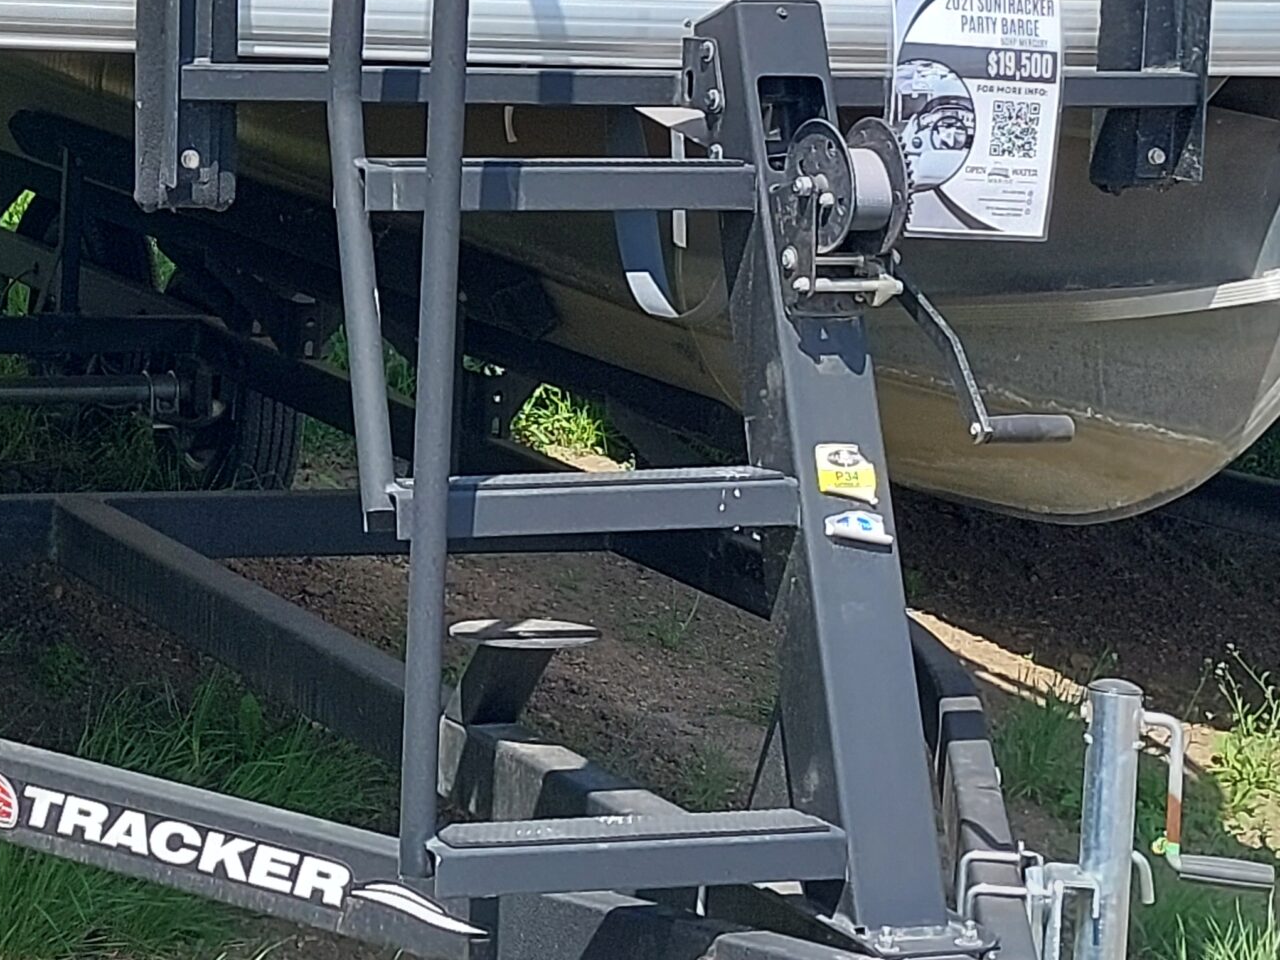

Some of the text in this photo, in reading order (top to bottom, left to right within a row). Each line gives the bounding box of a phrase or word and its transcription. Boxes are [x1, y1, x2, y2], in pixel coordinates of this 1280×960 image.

[960, 15, 1040, 37] PARTY BARGE
[987, 50, 1054, 81] $19,500
[976, 84, 1049, 97] FOR MORE INFO:
[965, 165, 1038, 177] OPEN WATER
[22, 784, 353, 909] TRACKER
